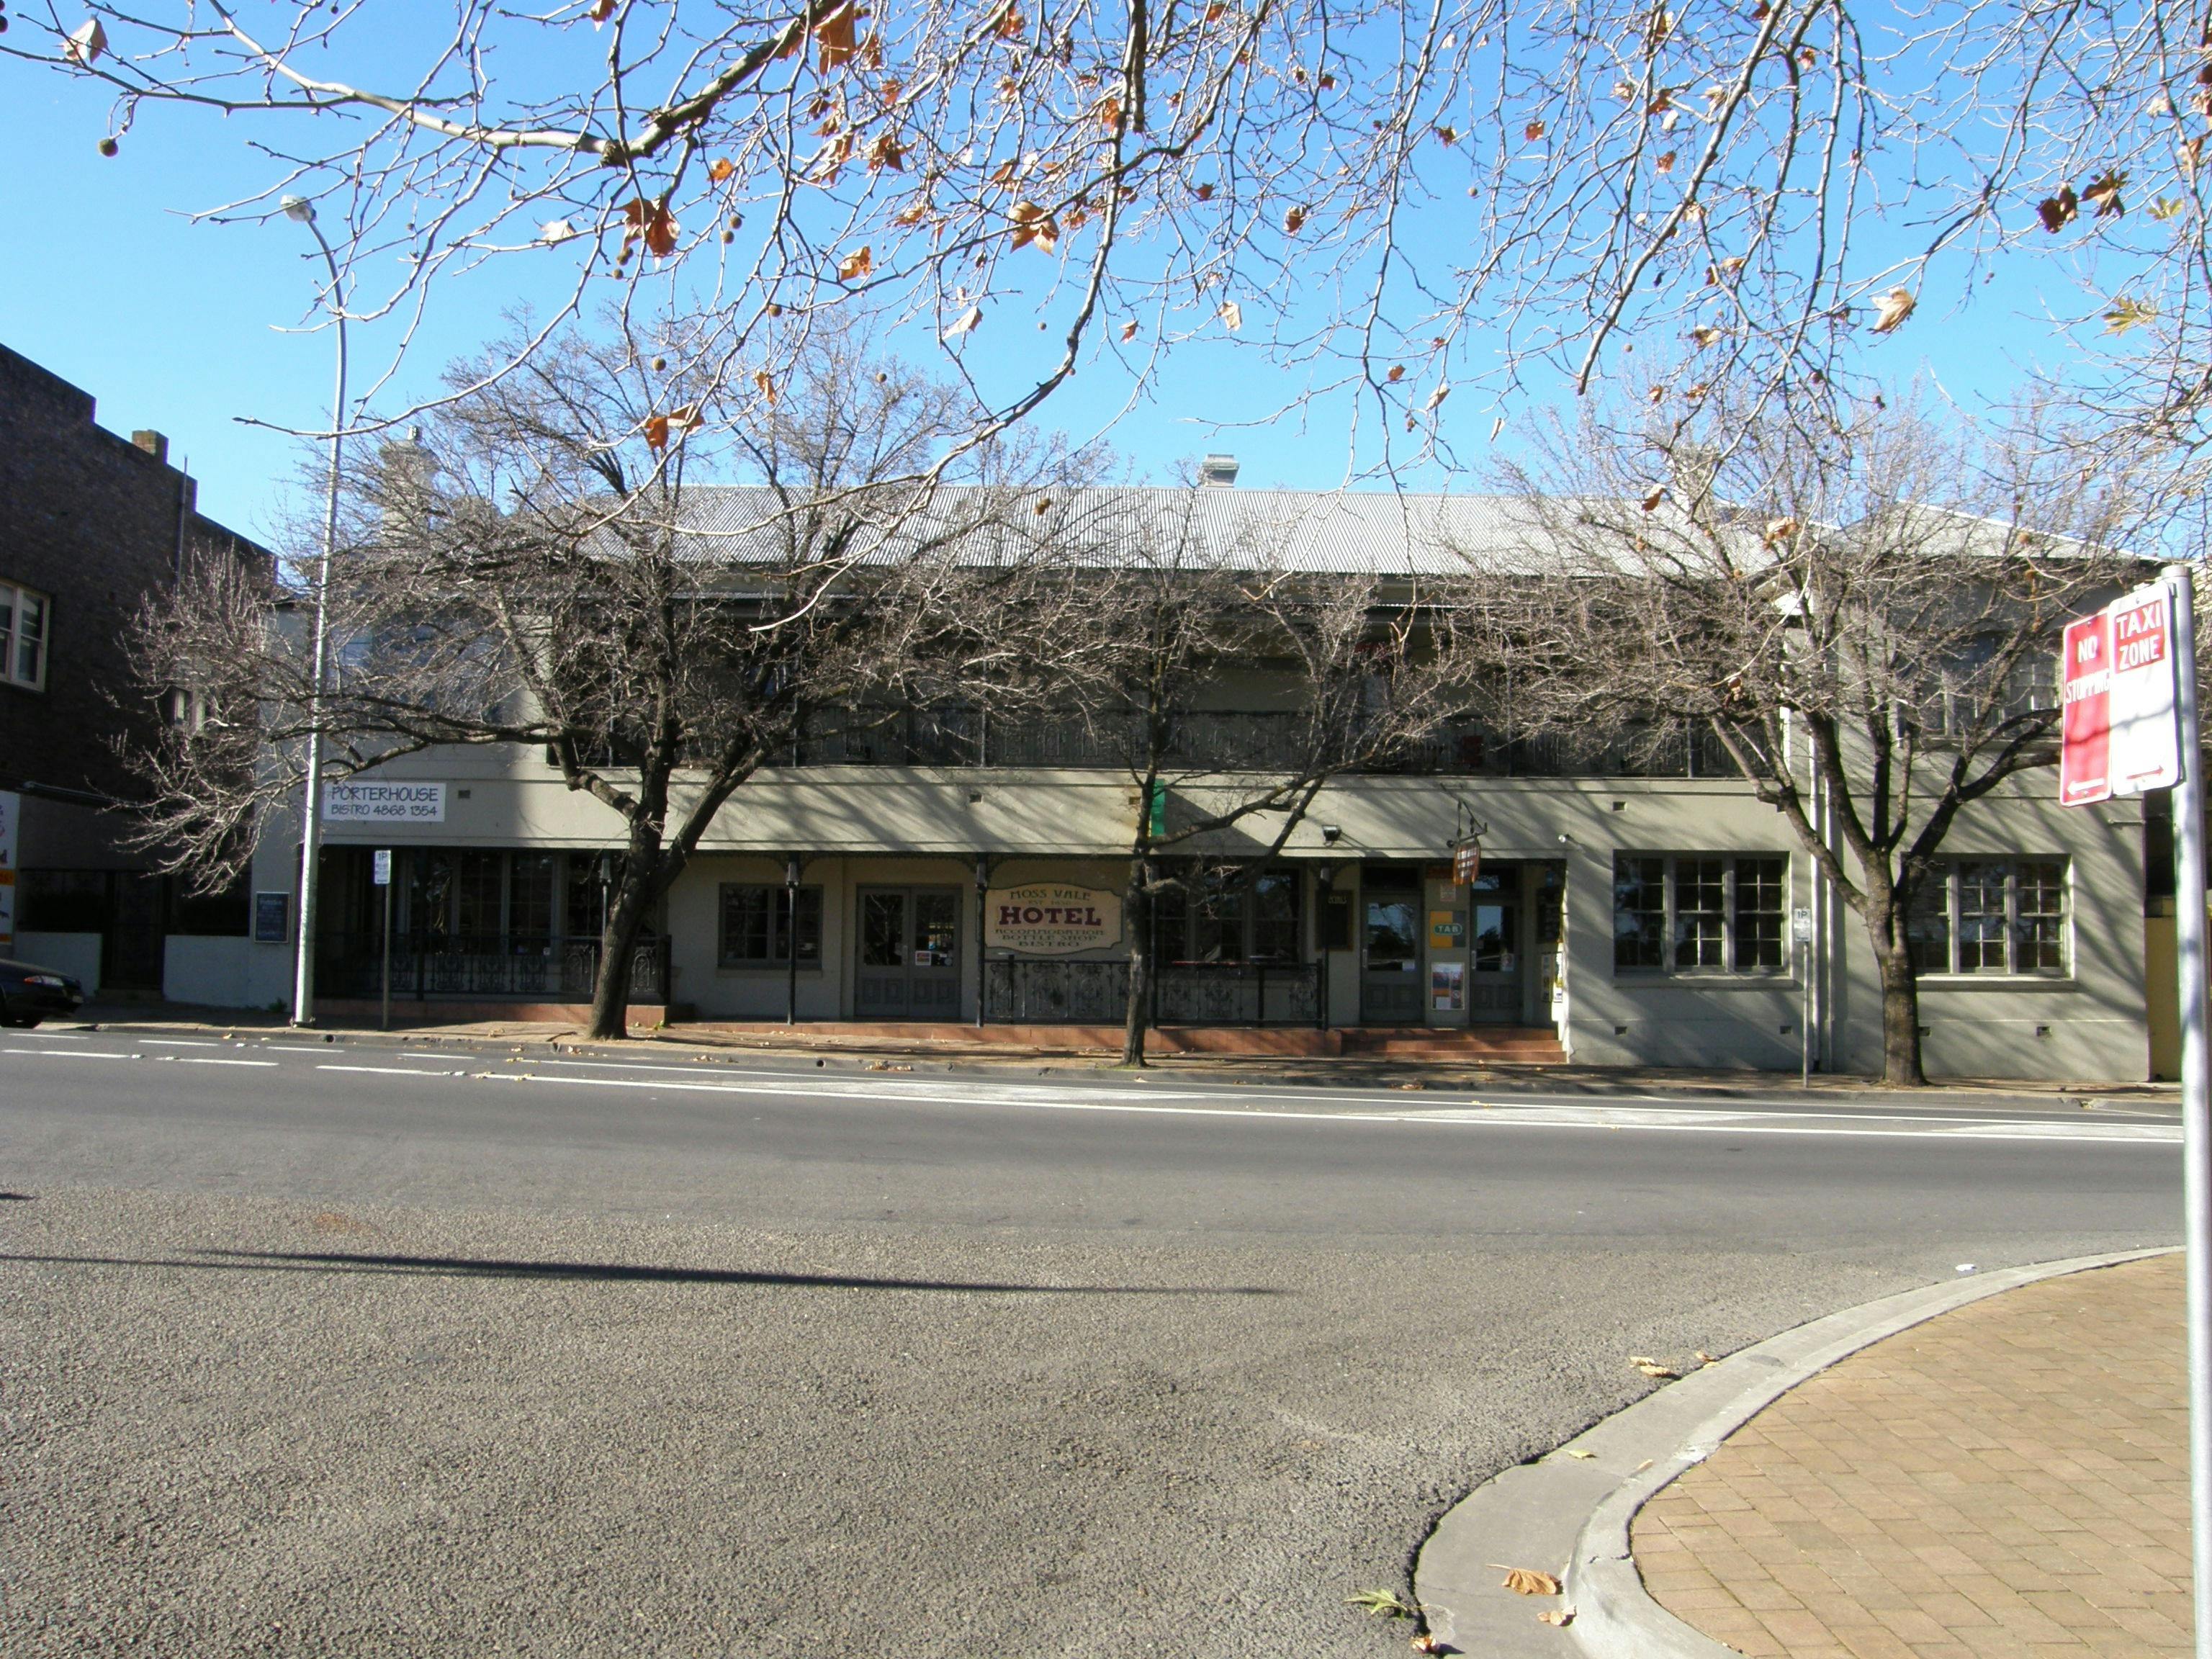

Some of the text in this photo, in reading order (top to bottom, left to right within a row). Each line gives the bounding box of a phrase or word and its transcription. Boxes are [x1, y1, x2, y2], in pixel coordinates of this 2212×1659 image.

[2116, 602, 2162, 640] TAXI
[2077, 634, 2098, 663] NO
[2118, 634, 2160, 670] ZONE
[331, 786, 439, 802] PORTERHOUSE
[331, 804, 438, 817] BISTRO 4868 1354
[1010, 889, 1091, 901] MOSS VALE
[999, 906, 1102, 926] HOTEL
